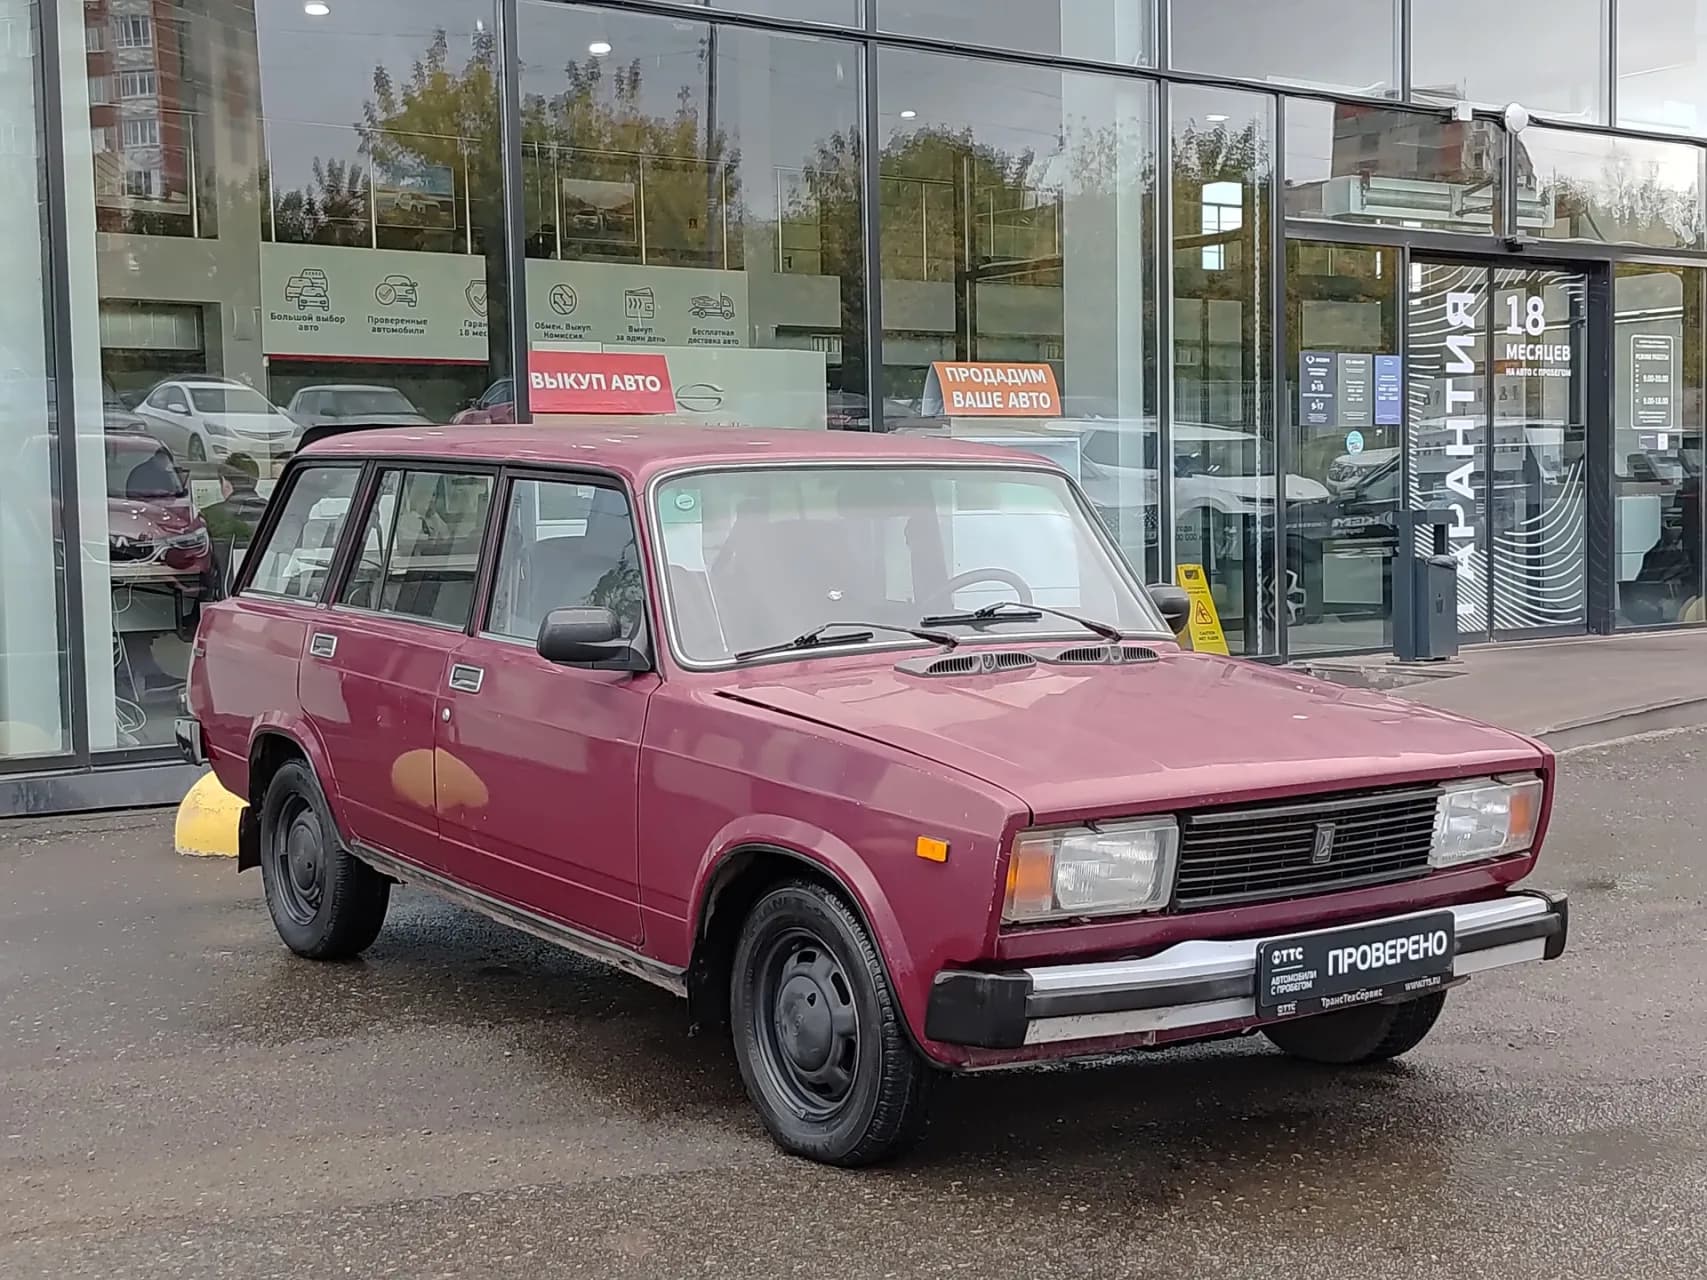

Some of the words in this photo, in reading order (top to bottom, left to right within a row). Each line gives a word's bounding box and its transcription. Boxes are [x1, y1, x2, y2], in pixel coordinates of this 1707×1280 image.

[270, 312, 313, 323] Большой
[316, 314, 346, 324] выбор
[367, 315, 428, 326] Проверенные
[1506, 295, 1545, 336] 18
[298, 324, 319, 332] авто
[371, 326, 425, 335] автомобили
[692, 328, 735, 337] Бесплатная
[688, 336, 721, 345] доставка
[1506, 344, 1571, 364] МЕСЯЦЕВ
[531, 372, 607, 391] ВЫКУП
[611, 374, 661, 392] АВТО
[945, 367, 1046, 385] ПРОДАДИМ
[952, 391, 1003, 408] ВАШЕ
[1008, 392, 1051, 409] АВТО
[1281, 947, 1303, 962] ТТС
[1328, 930, 1448, 976] ПРОВЕРЕНО
[1270, 969, 1318, 986] АВТОМОБИЛИ
[1270, 986, 1276, 996] С
[1276, 980, 1313, 995] ПРОБЕГОМ
[1320, 989, 1383, 1009] ТрансТехСервис
